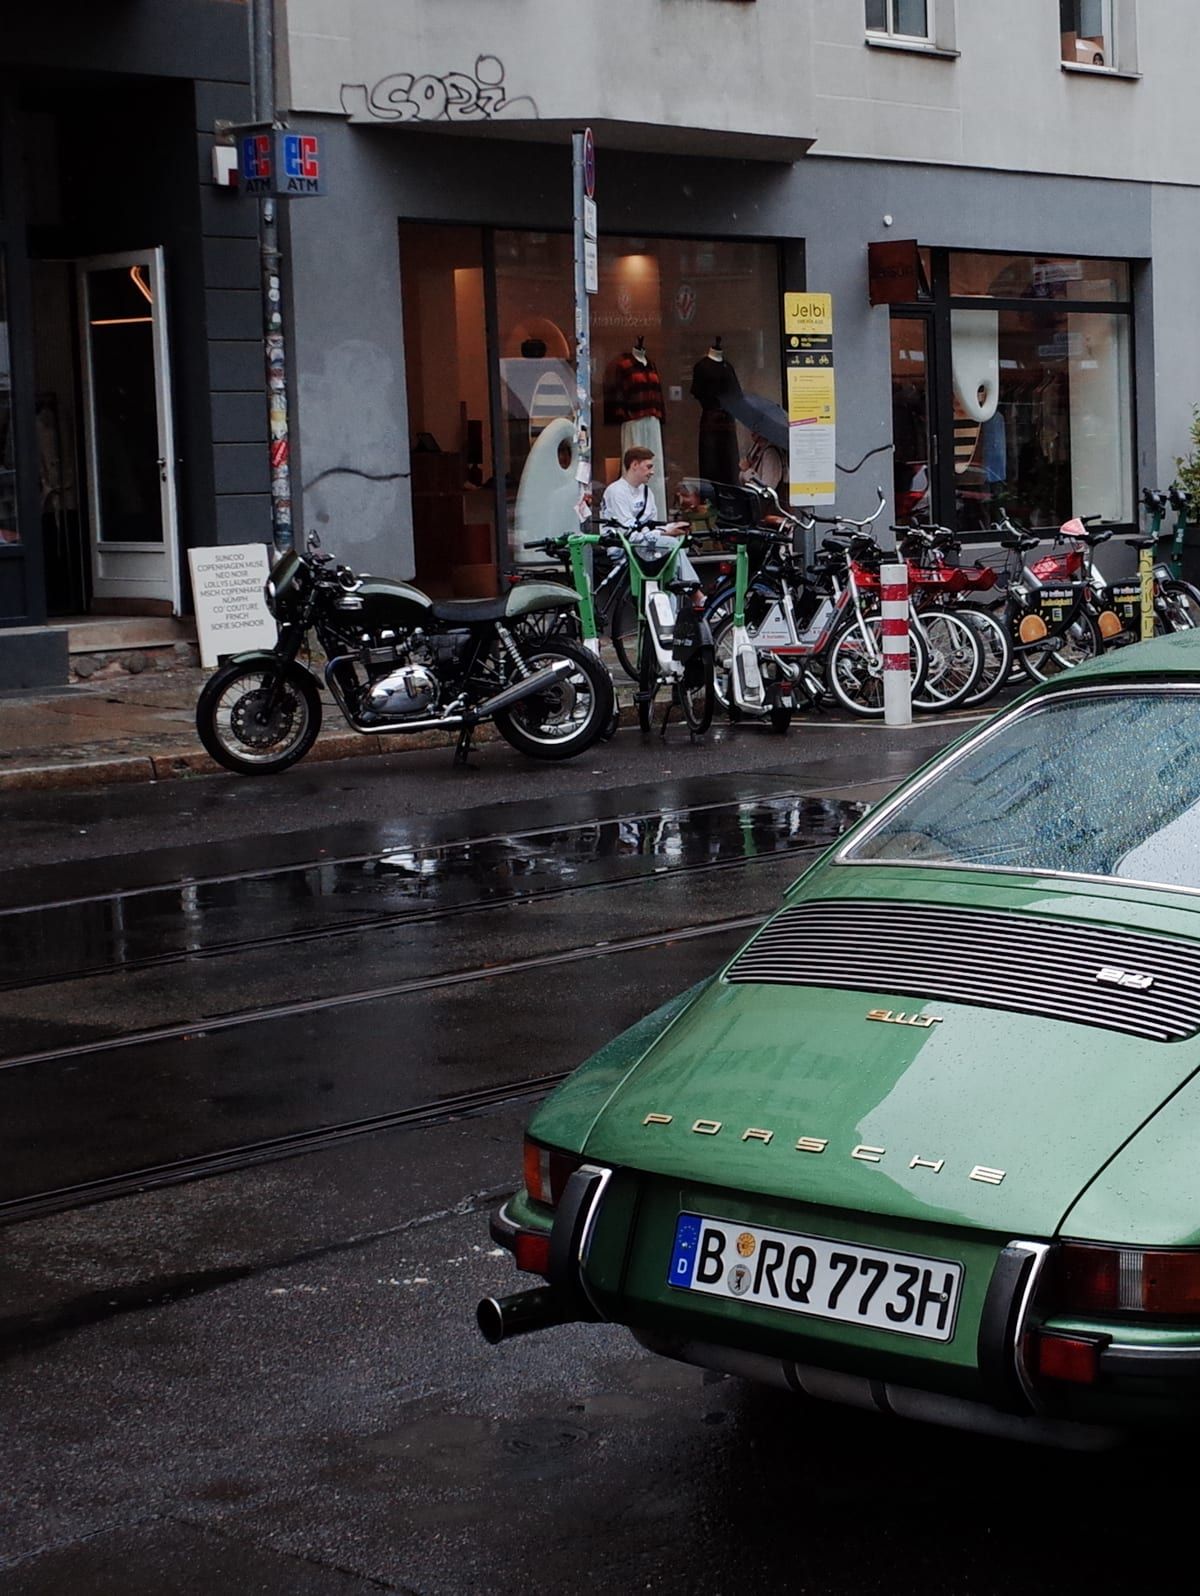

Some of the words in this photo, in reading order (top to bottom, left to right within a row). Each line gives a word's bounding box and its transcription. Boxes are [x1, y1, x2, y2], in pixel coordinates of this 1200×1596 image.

[287, 178, 319, 192] ATM
[791, 303, 826, 318] Jelbi
[215, 571, 230, 579] NEO
[642, 1112, 1007, 1186] PORSCHE
[676, 1258, 688, 1275] D
[696, 1228, 727, 1285] B
[752, 1239, 818, 1305] RQ
[826, 1252, 955, 1331] 773H
